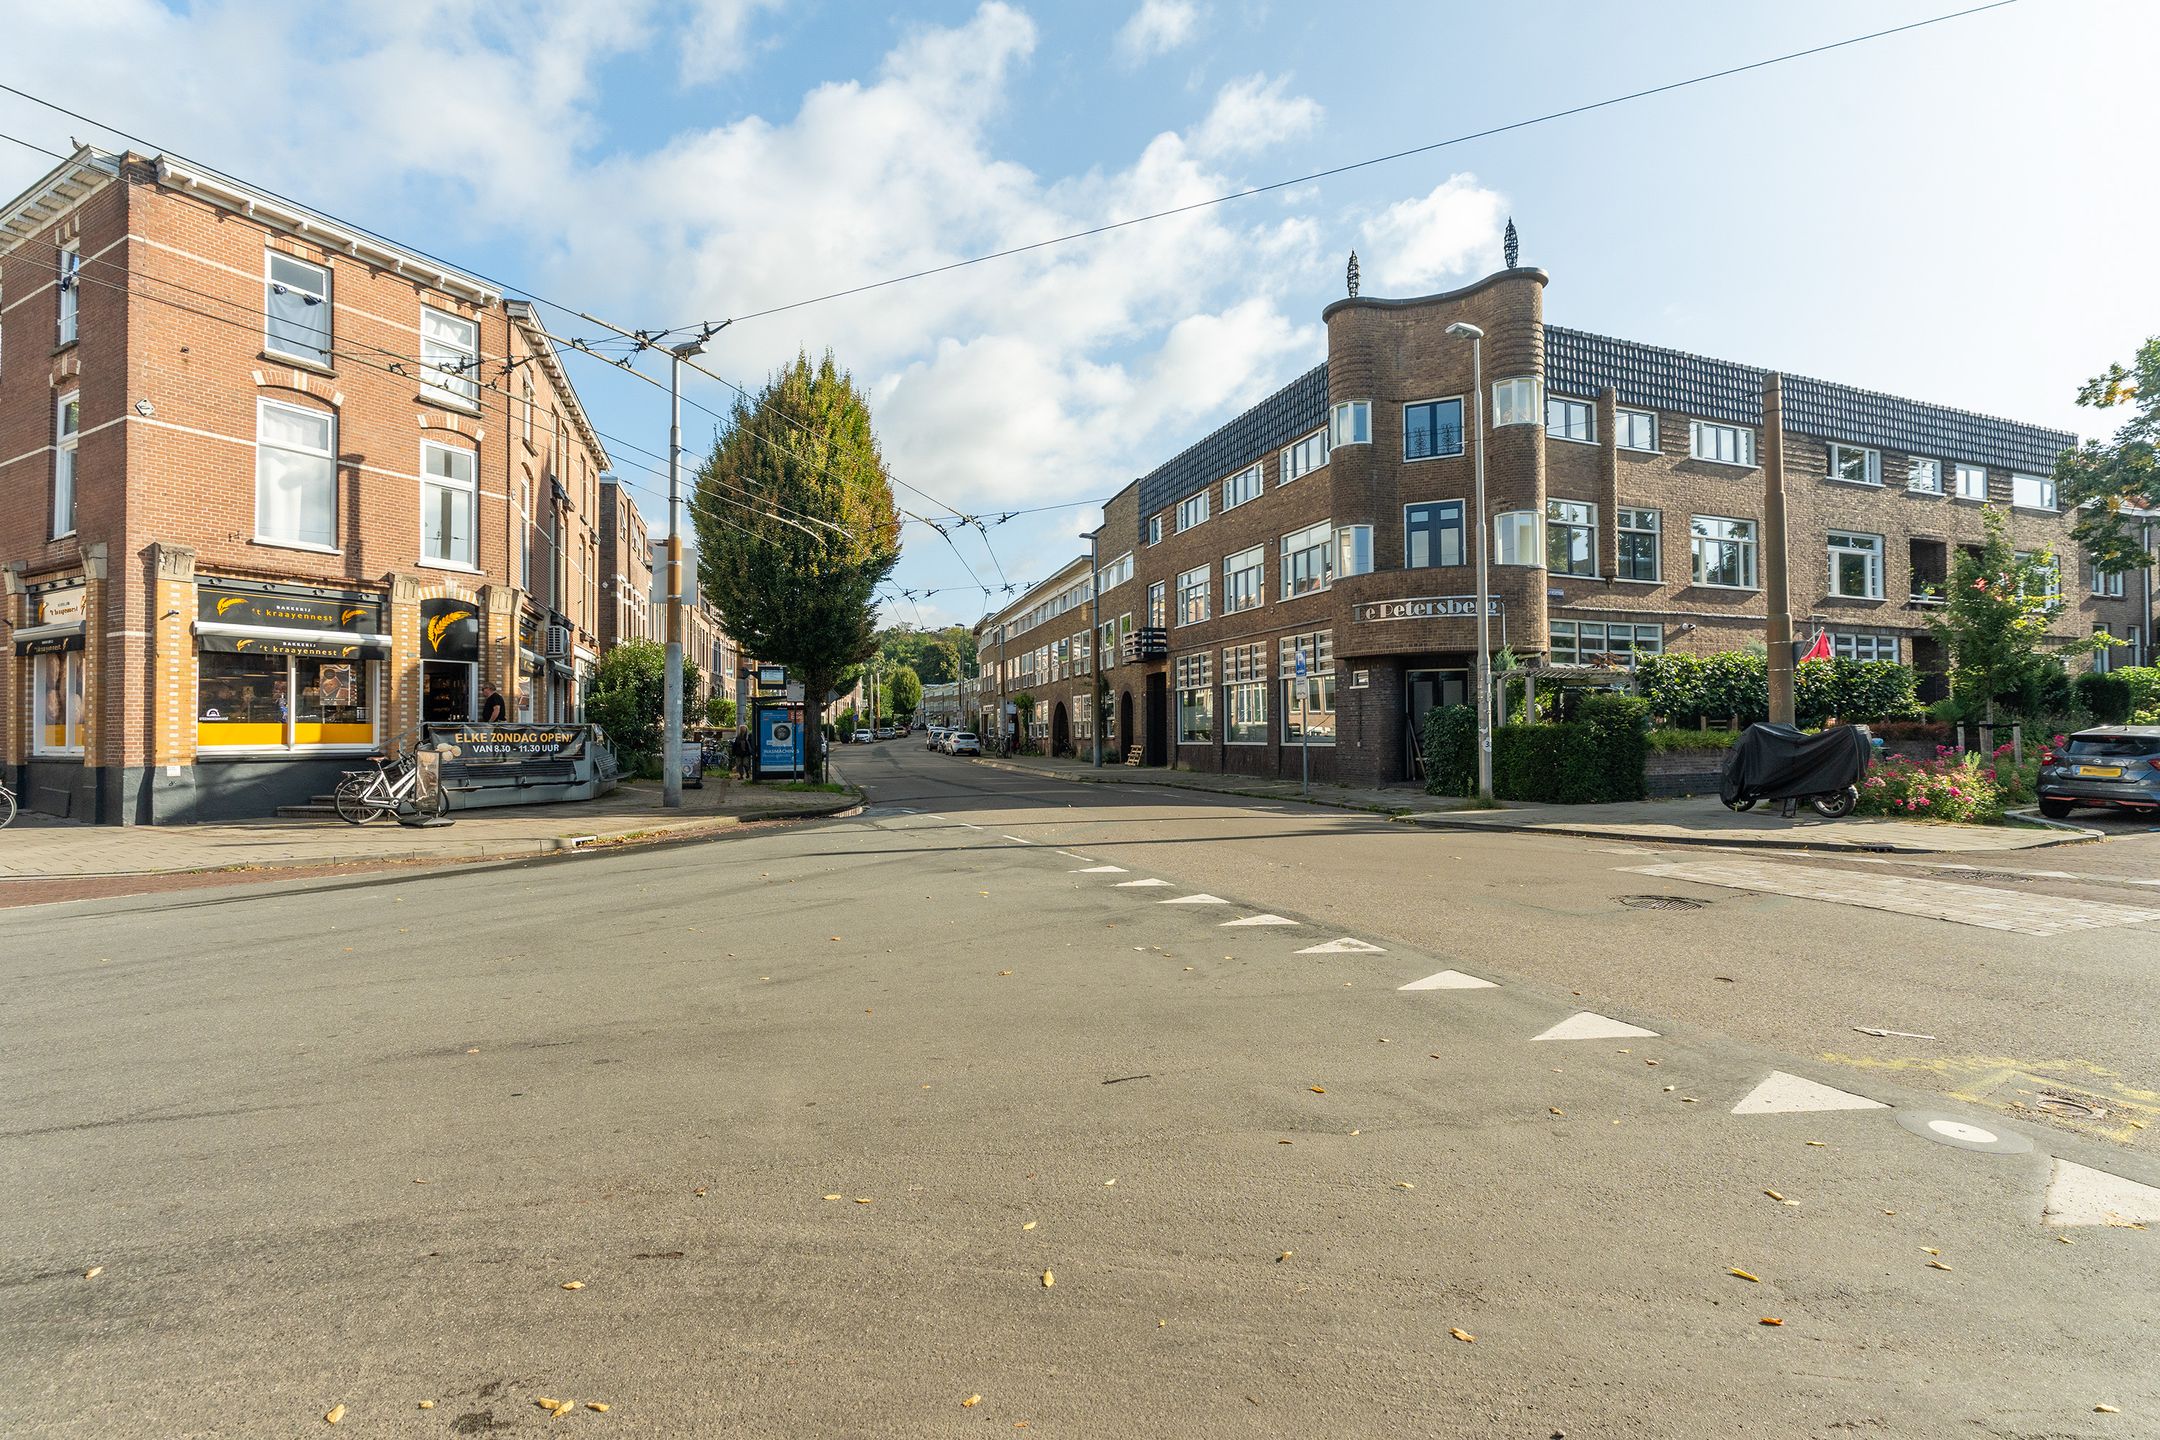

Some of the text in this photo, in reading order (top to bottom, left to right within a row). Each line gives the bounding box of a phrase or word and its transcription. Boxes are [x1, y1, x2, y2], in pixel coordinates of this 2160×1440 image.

[265, 609, 333, 622] kraayennest
[1354, 599, 1497, 621] De Petersbeg
[272, 645, 337, 656] kraayennest
[454, 732, 573, 743] ELKE ZONDAG OPEN!
[472, 744, 493, 753] VAN
[493, 744, 511, 753] 8.30
[518, 744, 540, 753] 11.30
[541, 743, 560, 752] UUR
